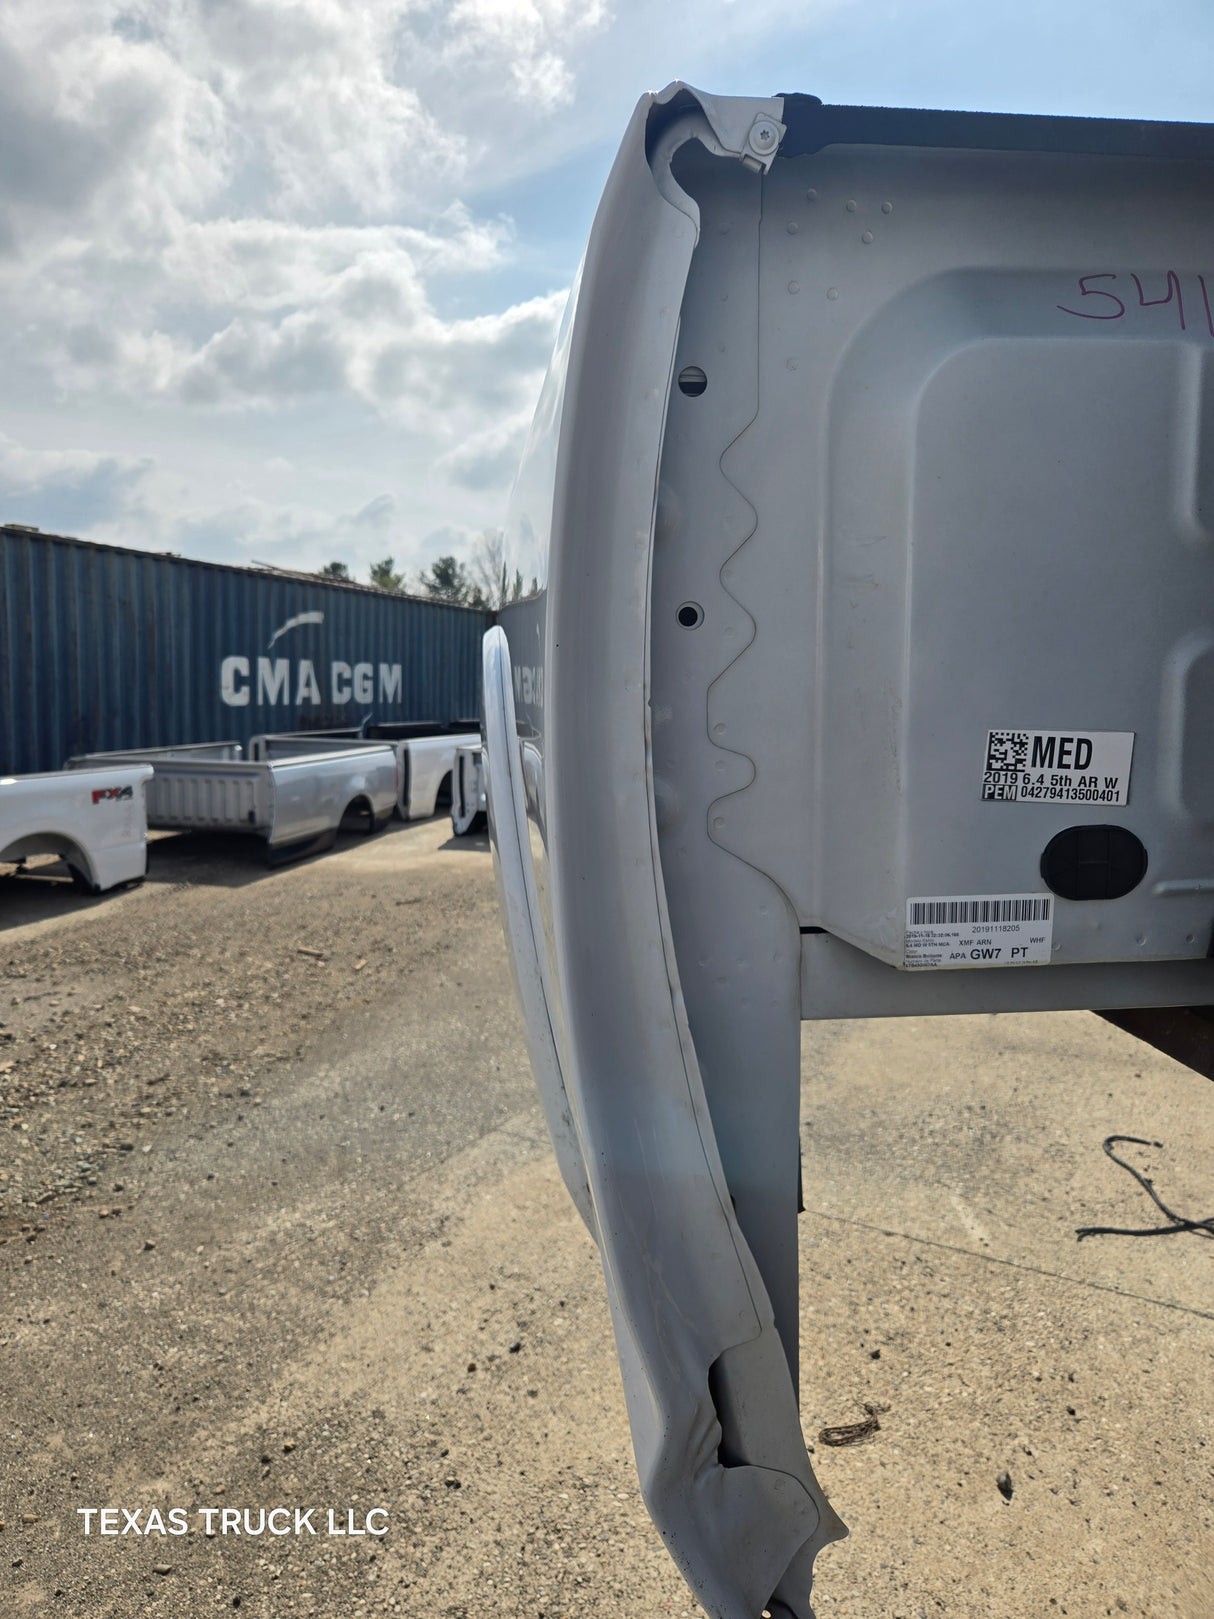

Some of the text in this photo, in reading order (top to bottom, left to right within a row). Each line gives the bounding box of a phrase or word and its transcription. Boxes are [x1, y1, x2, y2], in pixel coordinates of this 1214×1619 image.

[220, 655, 403, 708] CMA CGM
[1031, 735, 1093, 771] MED
[983, 771, 1119, 789] 2019 6.4 5th AR W
[92, 785, 134, 805] FX4
[984, 785, 1120, 802] PEM 04279413500401
[971, 924, 1020, 934] 20191118205
[958, 936, 1046, 947] XMF ARN WHF
[949, 947, 1029, 960] APA GW7 PT
